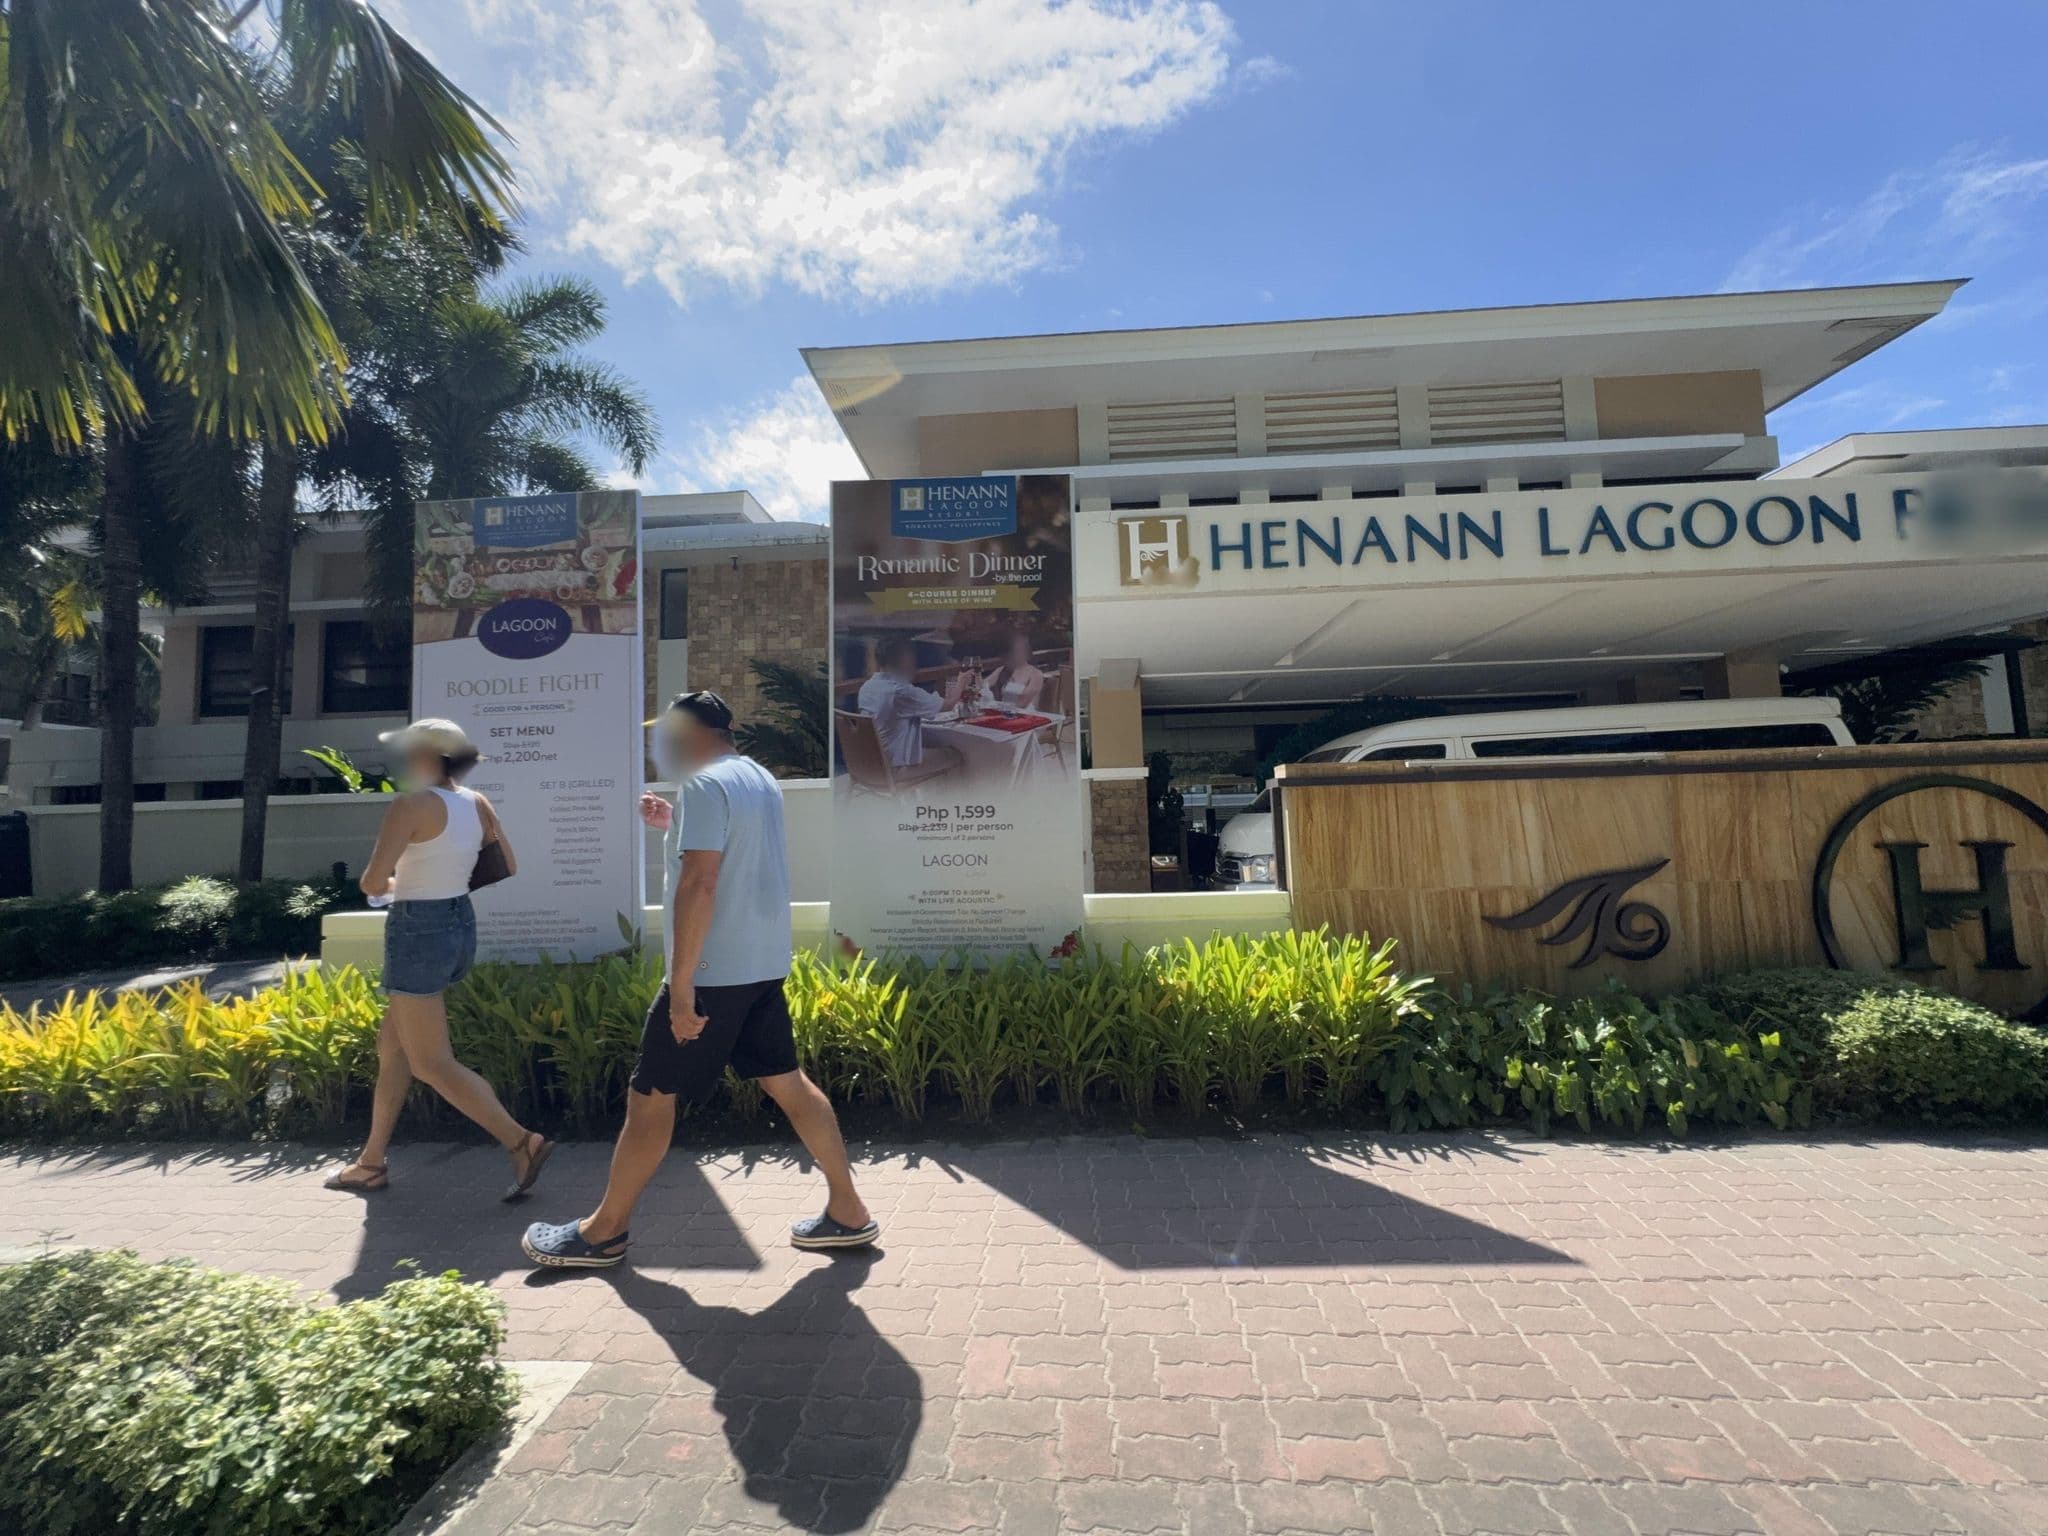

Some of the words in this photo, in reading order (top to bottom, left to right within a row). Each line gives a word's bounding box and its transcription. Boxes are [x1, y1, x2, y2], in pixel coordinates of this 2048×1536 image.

[928, 485, 1008, 500] HENANN
[506, 503, 567, 518] HENANN
[928, 500, 1008, 511] LAGOON
[1209, 510, 1504, 570] HENANN
[1537, 492, 1862, 557] LAGOON
[858, 554, 960, 581] Romantic
[969, 551, 1047, 578] Dinner
[1023, 573, 1042, 583] pool
[961, 588, 997, 597] DINNER
[492, 618, 557, 633] LAGOON
[447, 677, 528, 698] BOODLE
[539, 672, 603, 693] FIGHT
[490, 727, 513, 738] SET
[516, 725, 554, 738] MENU
[539, 780, 557, 790] SET
[916, 806, 949, 822] Php
[954, 805, 996, 821] 1,599
[956, 824, 974, 832] per
[977, 823, 1014, 832] person
[923, 854, 988, 867] LAGOON
[1874, 839, 2032, 971] H
